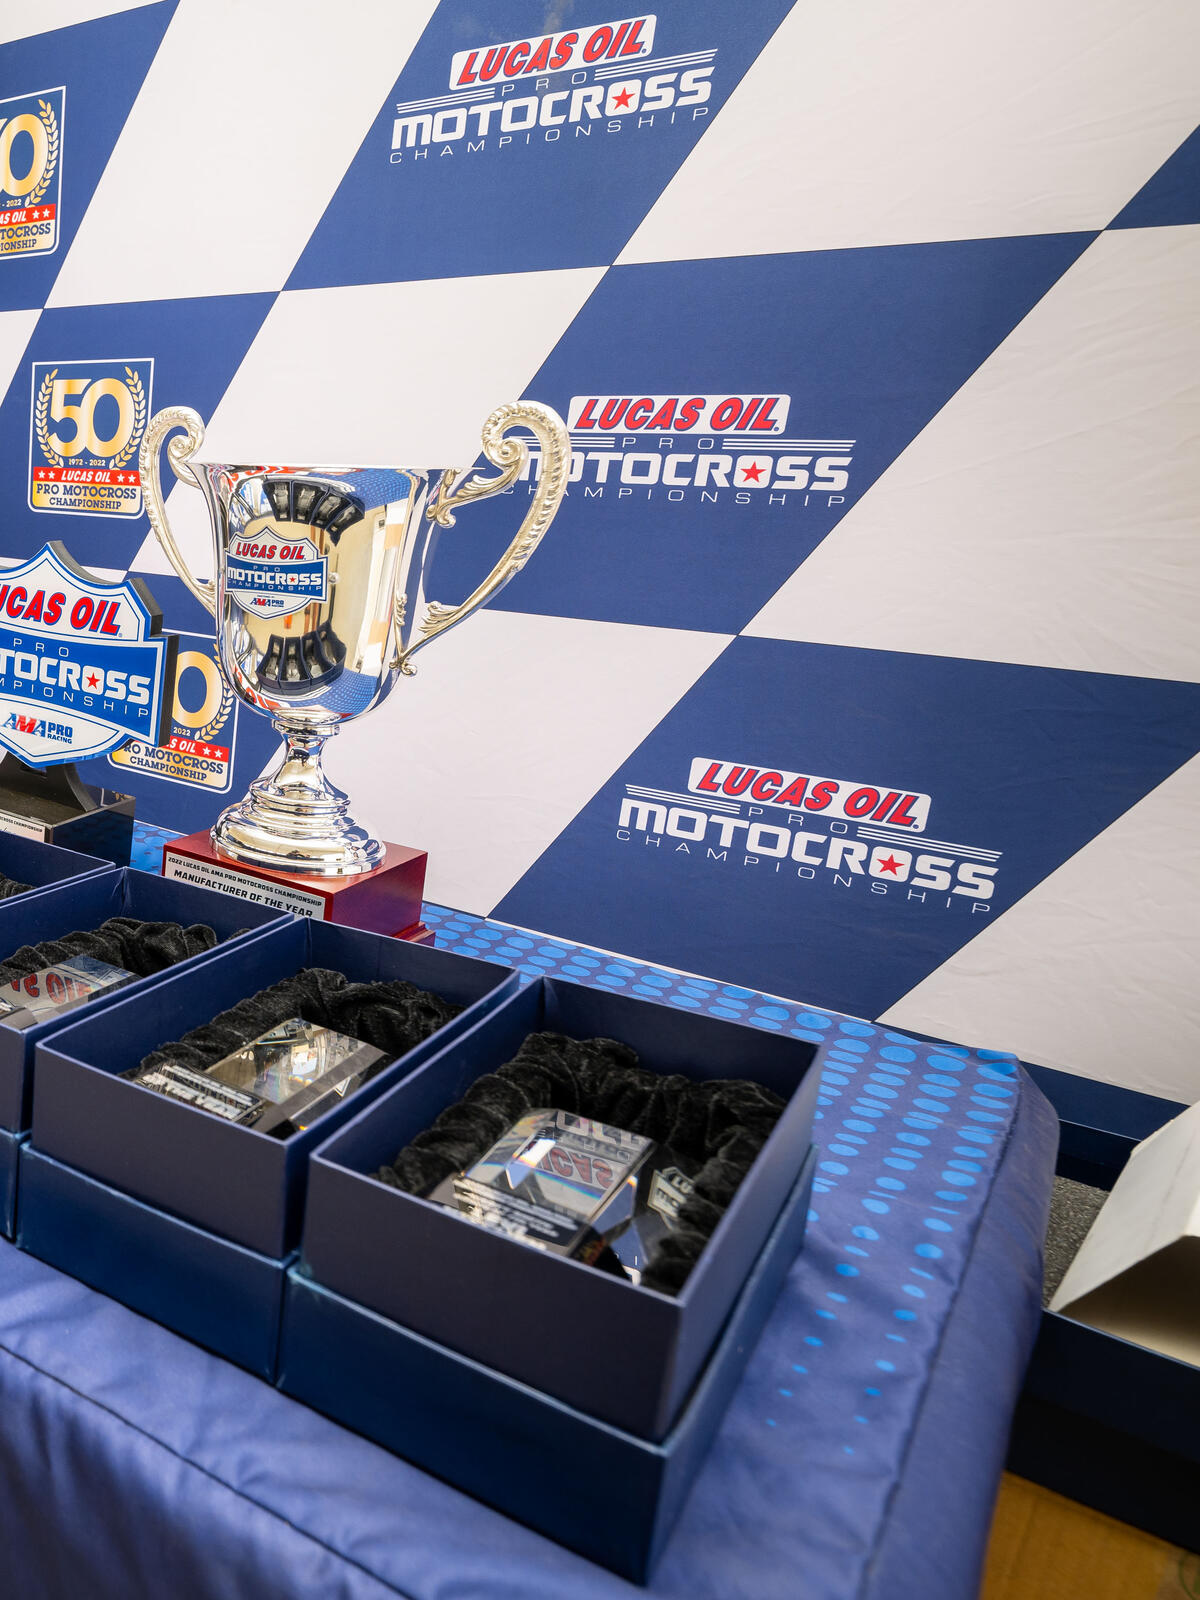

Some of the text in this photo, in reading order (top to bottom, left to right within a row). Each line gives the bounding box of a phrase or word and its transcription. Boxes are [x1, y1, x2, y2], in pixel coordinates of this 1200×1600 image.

[456, 20, 642, 86] LUCAS OIL
[502, 71, 586, 97] PRO
[390, 66, 715, 150] MOTOCROSS
[389, 107, 709, 164] CHAMPIONSHIP
[6, 199, 22, 208] 2022
[12, 210, 27, 224] OIL
[47, 378, 135, 457] 50
[574, 397, 776, 432] LUCAS OIL
[622, 437, 714, 450] PRO
[89, 459, 106, 467] 2022
[61, 470, 111, 483] LUCAS OIL
[36, 483, 137, 500] PRO MOTOCROSS
[49, 497, 122, 510] CHAMPIONSHIP
[236, 542, 305, 560] LUCAS OIL
[227, 567, 322, 586] MOTOCROSS
[227, 580, 322, 591] CHAMPIONSHIP
[70, 597, 121, 636] OIL
[13, 638, 69, 657] PRO
[171, 651, 223, 728] 0
[1, 712, 73, 737] AMA PRO
[47, 733, 72, 744] RACING
[179, 740, 197, 754] OIL
[129, 756, 208, 782] CHAMPIONSHIP
[144, 747, 224, 775] MOTOCROSS
[695, 762, 916, 828] LUCAS OIL
[748, 806, 848, 835] PRO
[618, 798, 999, 900] MOTOCROSS
[168, 856, 322, 907] 2022 LUCAS OIL AMA PRO MOTOCROSS CHAMPIONSHIP
[616, 829, 990, 914] CHAMPIONSHIP
[174, 869, 313, 917] MANUFACTURER OF THE YEAR
